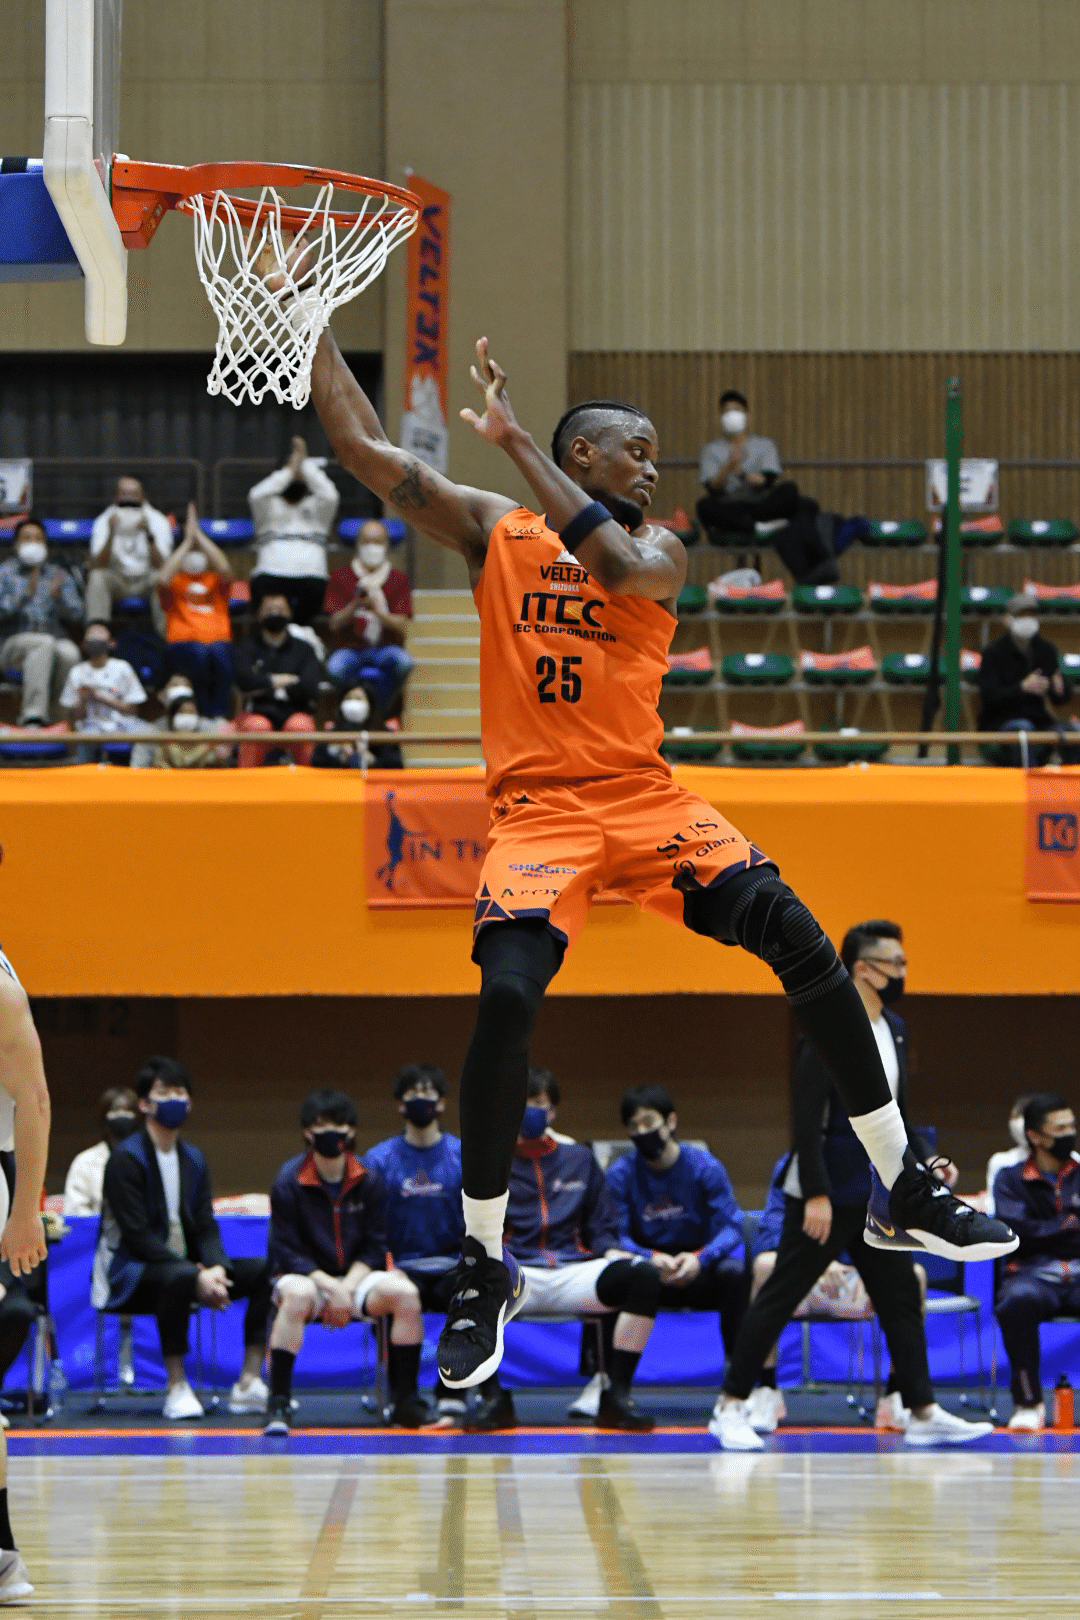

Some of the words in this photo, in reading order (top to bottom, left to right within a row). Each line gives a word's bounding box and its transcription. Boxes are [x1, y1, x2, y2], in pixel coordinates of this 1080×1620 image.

[550, 583, 580, 592] SHIZUOKA
[520, 592, 605, 628] ITEC
[534, 624, 617, 642] CORPORATION
[536, 655, 582, 703] 25
[657, 818, 718, 860] SUS
[696, 837, 738, 857] Glanz
[410, 841, 442, 860] IN
